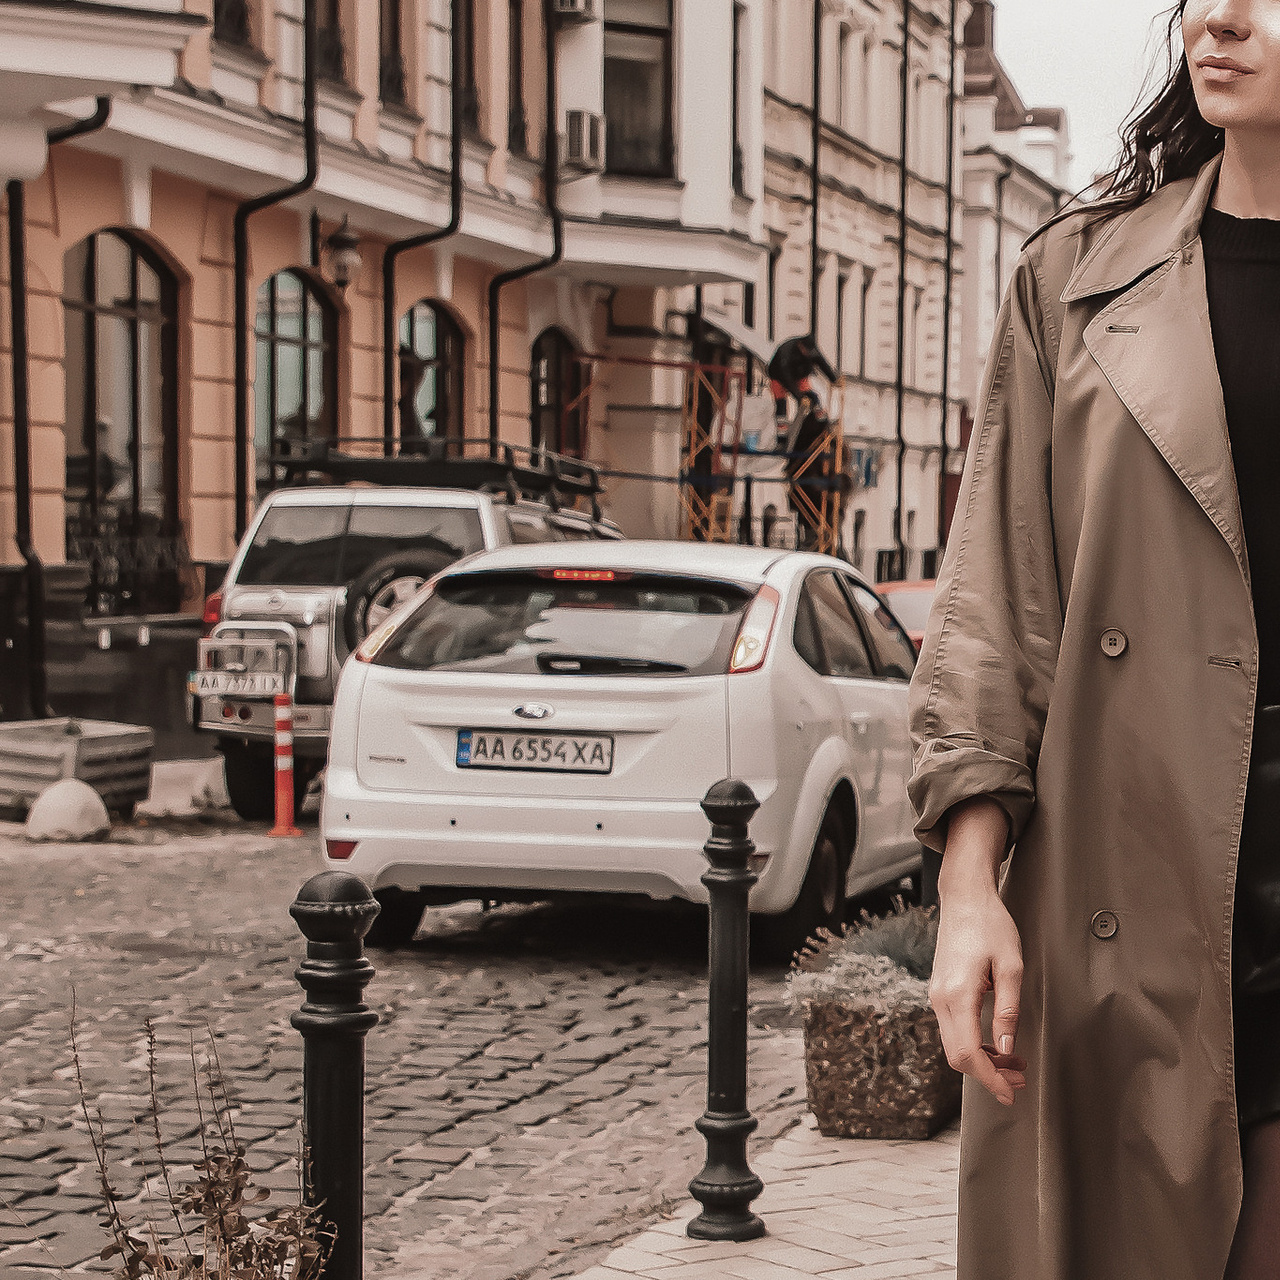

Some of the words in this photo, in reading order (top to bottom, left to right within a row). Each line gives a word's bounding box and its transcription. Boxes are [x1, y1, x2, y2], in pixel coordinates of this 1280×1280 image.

[474, 736, 505, 761] AA
[512, 738, 567, 763] 6554
[572, 740, 604, 764] XA
